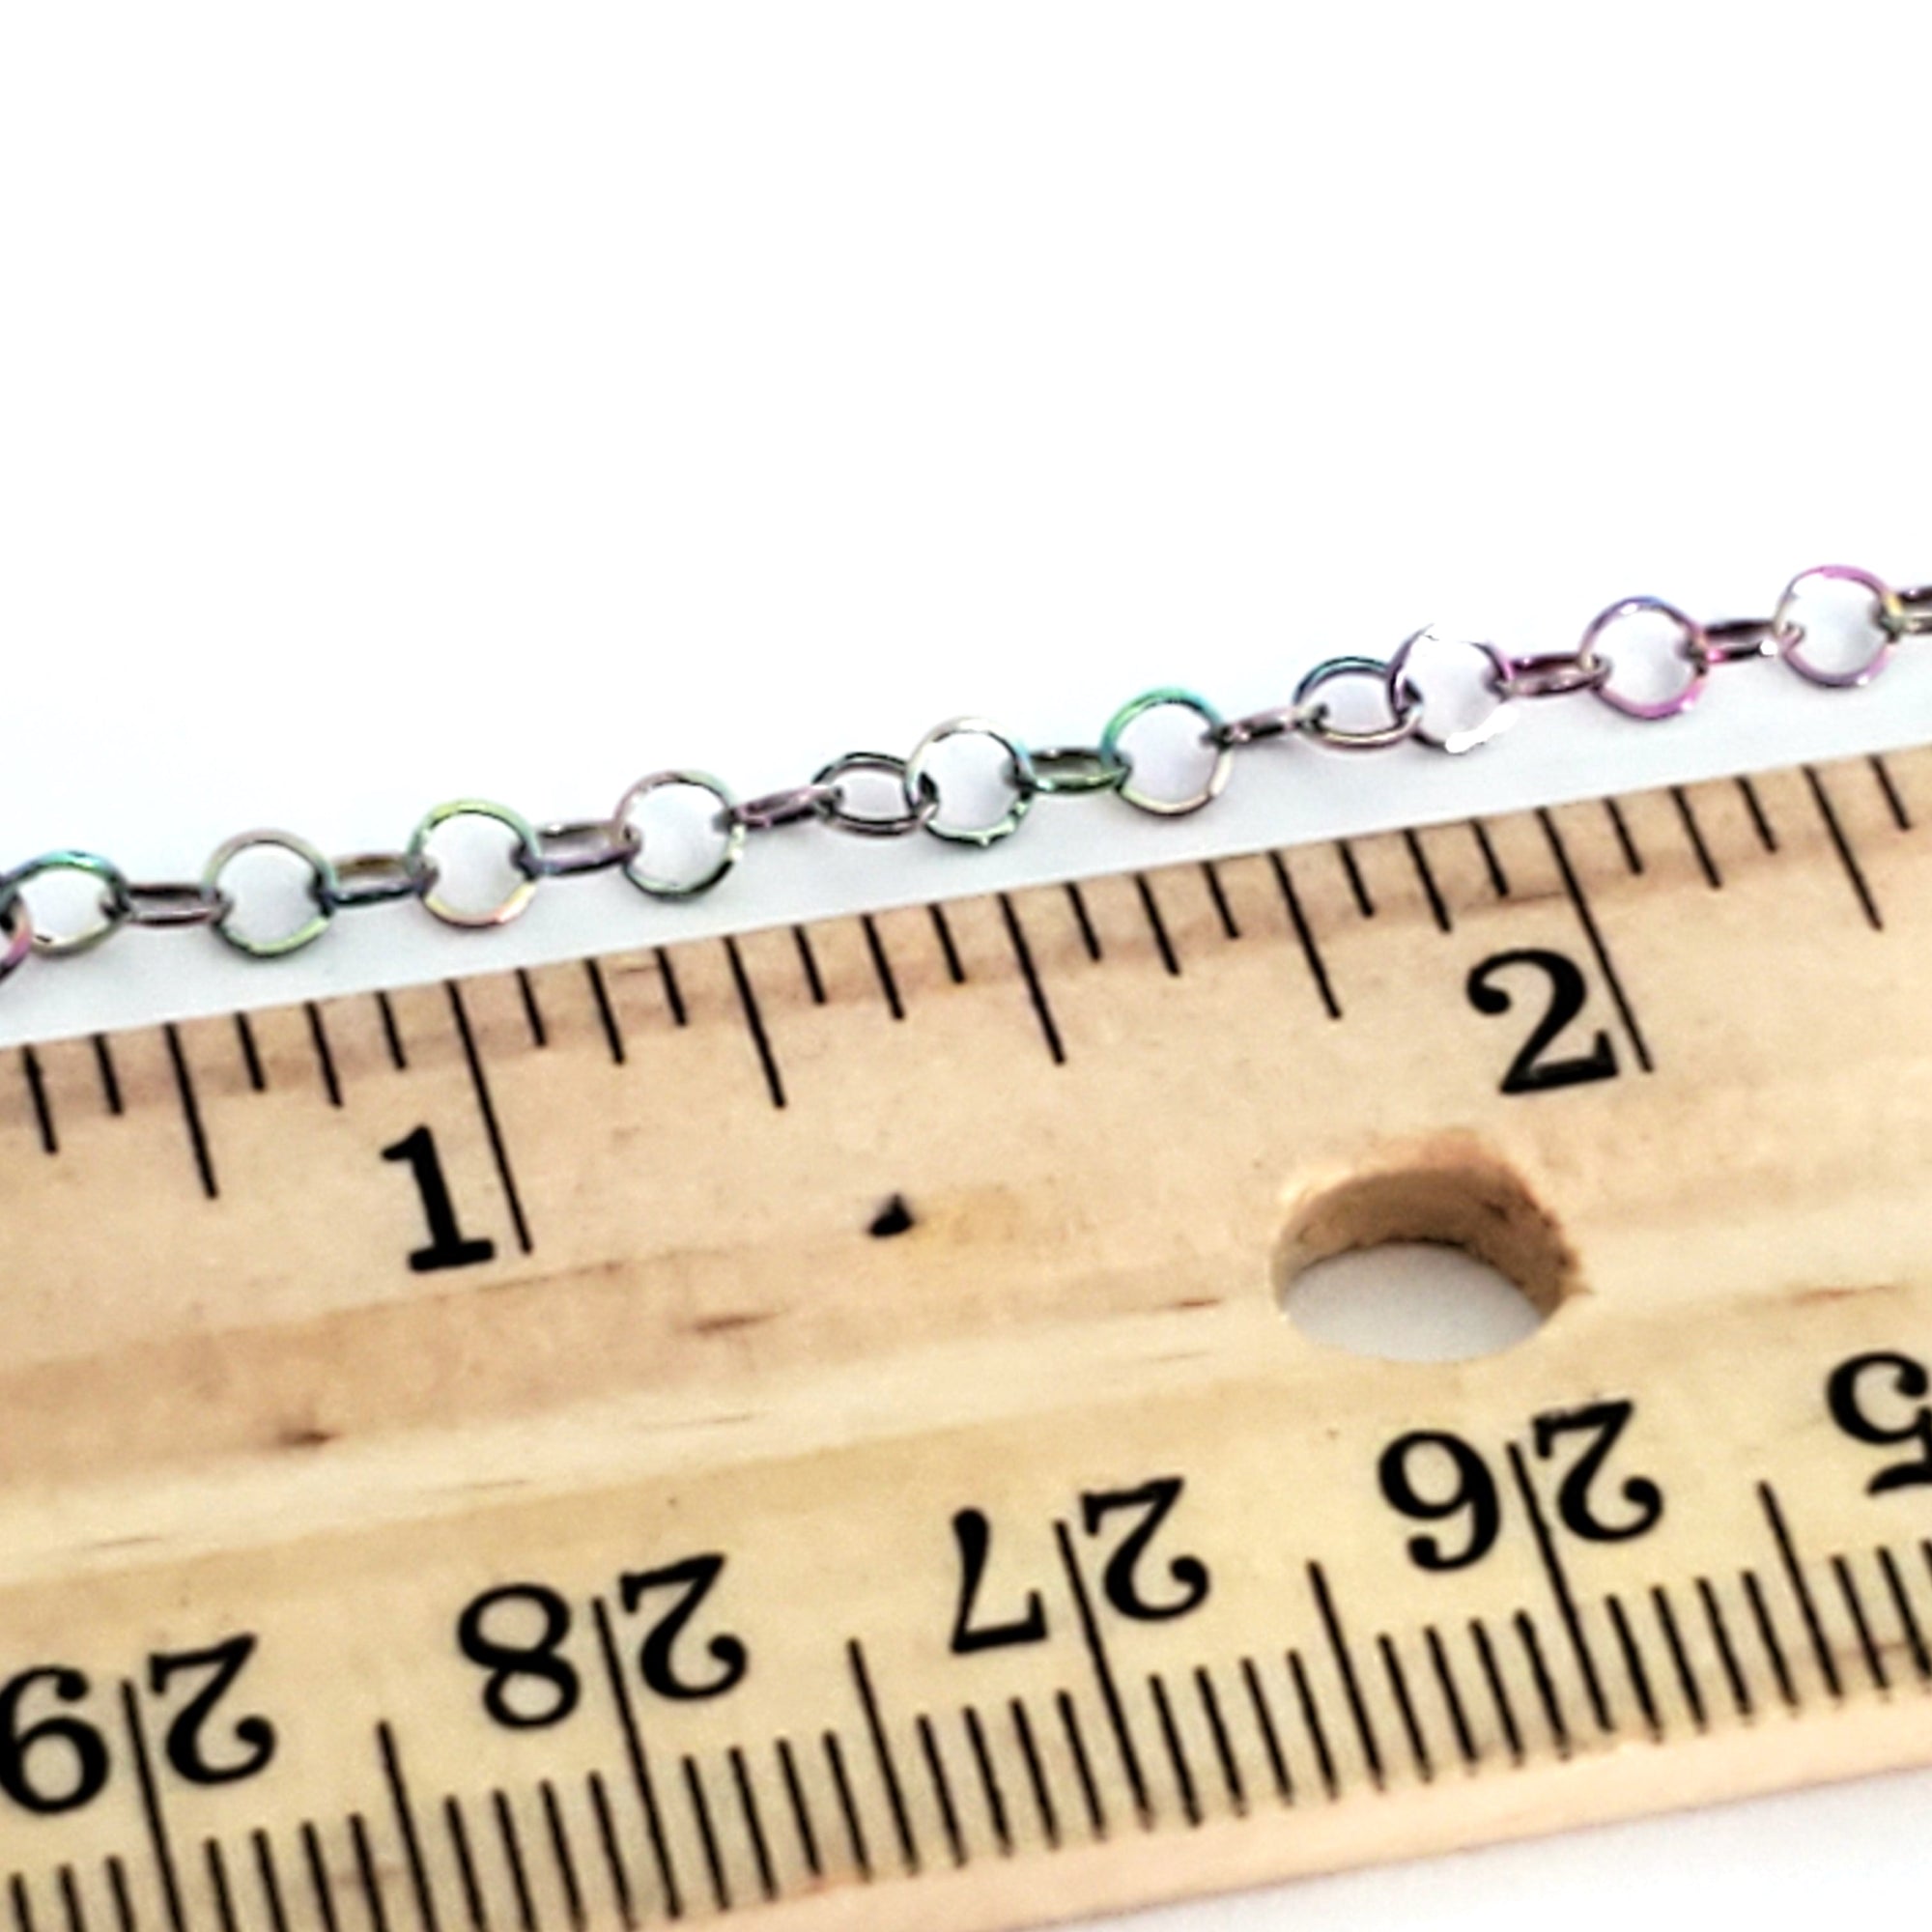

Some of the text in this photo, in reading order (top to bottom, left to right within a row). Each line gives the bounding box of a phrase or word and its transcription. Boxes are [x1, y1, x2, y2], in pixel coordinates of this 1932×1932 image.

[1464, 948, 1620, 1096] 2
[380, 1124, 497, 1274] 1
[950, 1476, 1211, 1656] 27
[1378, 1400, 1663, 1573] 26
[456, 1553, 749, 1731] 28
